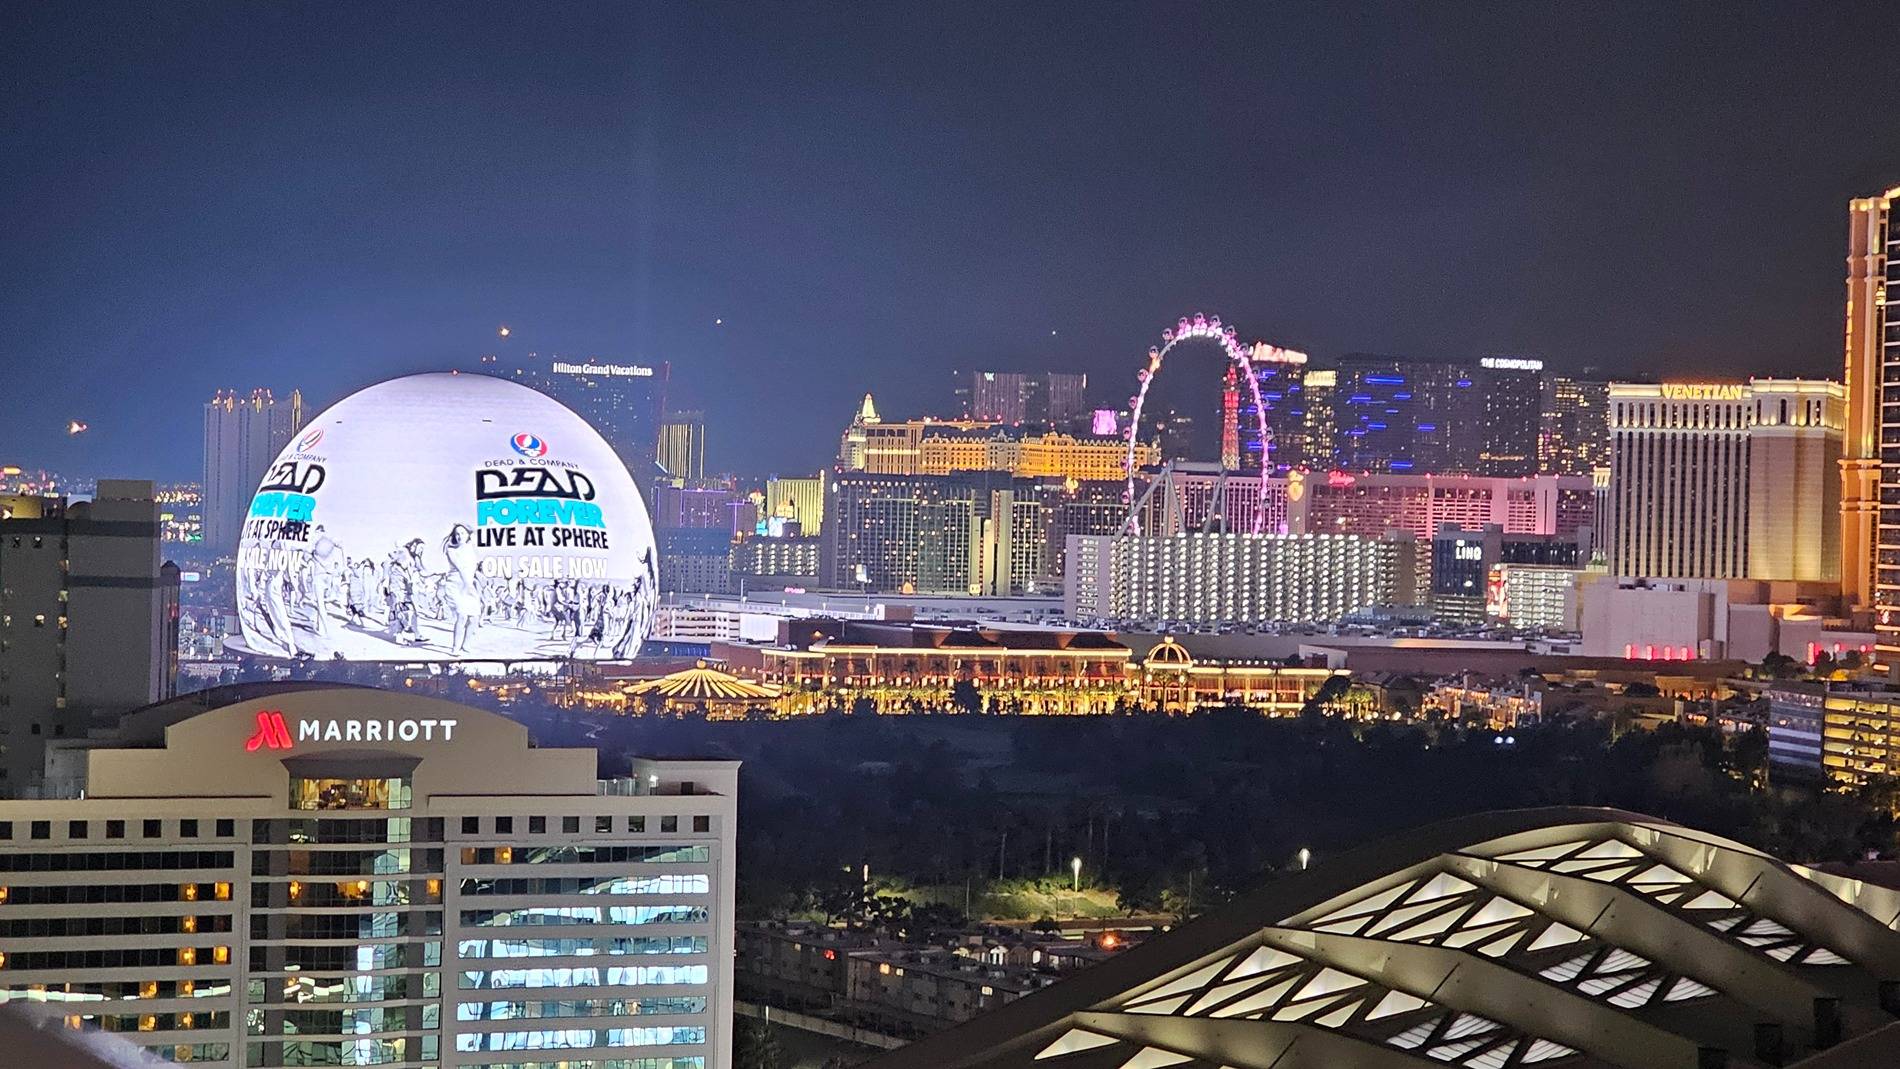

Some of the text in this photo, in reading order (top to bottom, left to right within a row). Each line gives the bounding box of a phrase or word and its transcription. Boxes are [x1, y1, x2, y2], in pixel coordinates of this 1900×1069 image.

[553, 362, 653, 376] Hilton Grand Vacations
[1495, 358, 1543, 370] COSMOPOLITAN
[1661, 383, 1743, 400] VENETIAN
[484, 459, 514, 468] DEAD
[529, 459, 579, 469] COMPANY
[475, 467, 596, 501] DEAD
[476, 500, 606, 529] FOREVER
[264, 519, 311, 542] SPHERE
[476, 527, 609, 549] LIVE AT SPHERE
[1455, 546, 1482, 561] LINQ
[481, 555, 608, 580] ON SALE NOW
[298, 719, 457, 742] MARRIOTT
